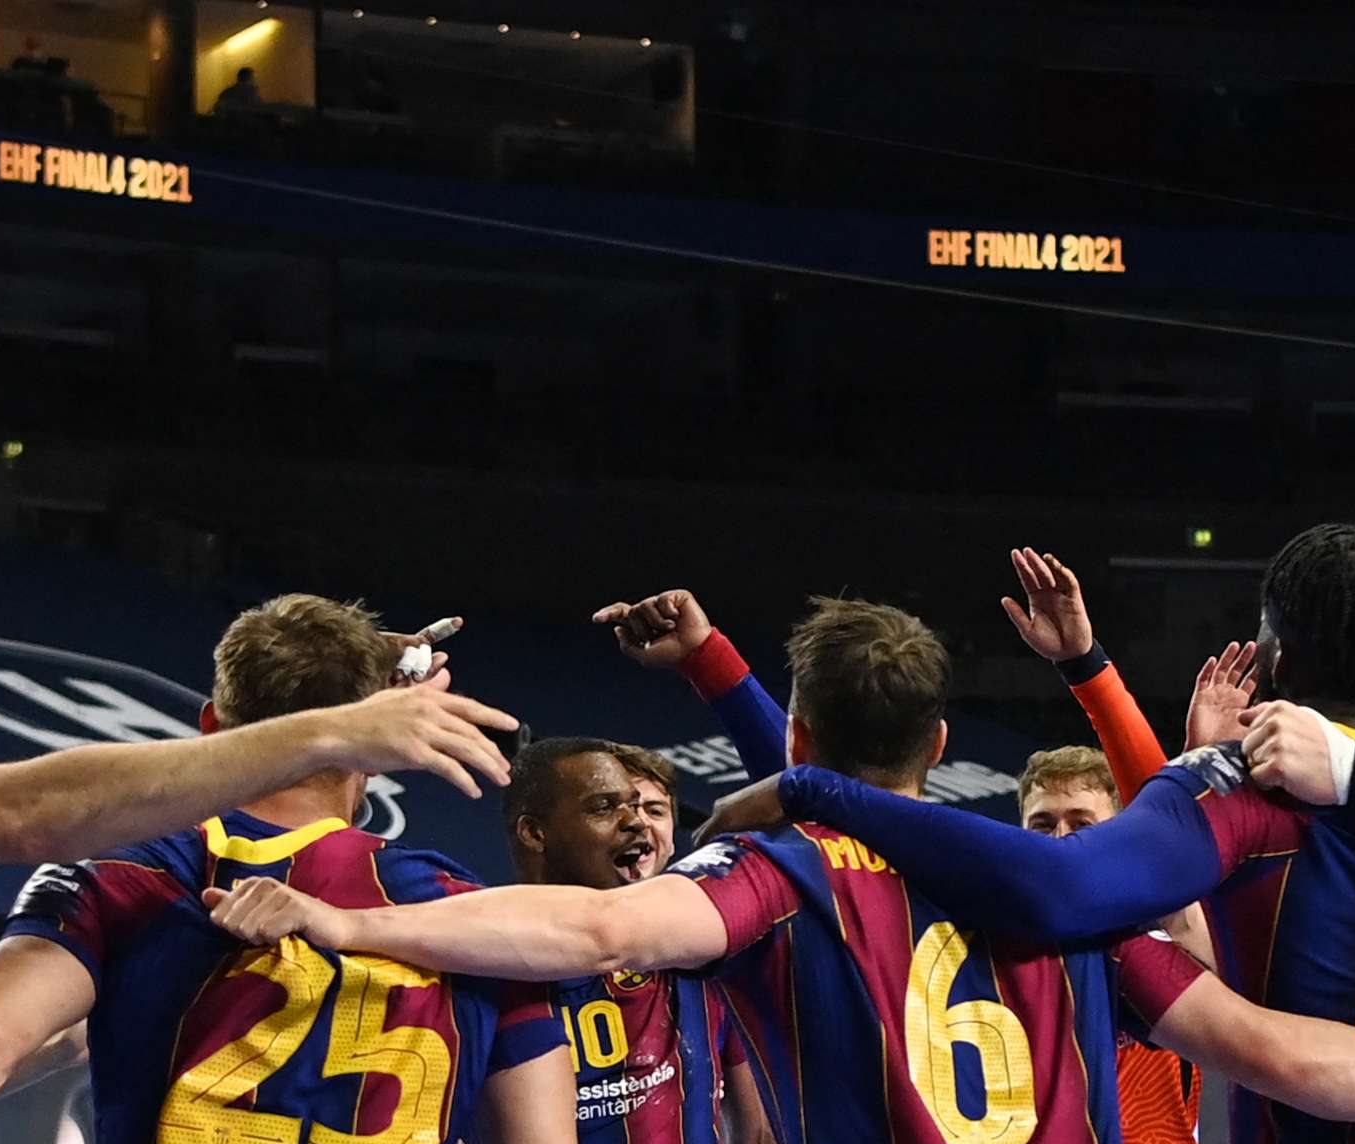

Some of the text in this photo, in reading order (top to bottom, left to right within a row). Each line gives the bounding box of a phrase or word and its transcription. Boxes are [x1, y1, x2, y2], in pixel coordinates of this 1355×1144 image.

[0, 141, 193, 203] EHF FINAL4 2021
[929, 229, 1126, 273] EHF FINAL4 2021
[576, 1060, 676, 1101] ssistència
